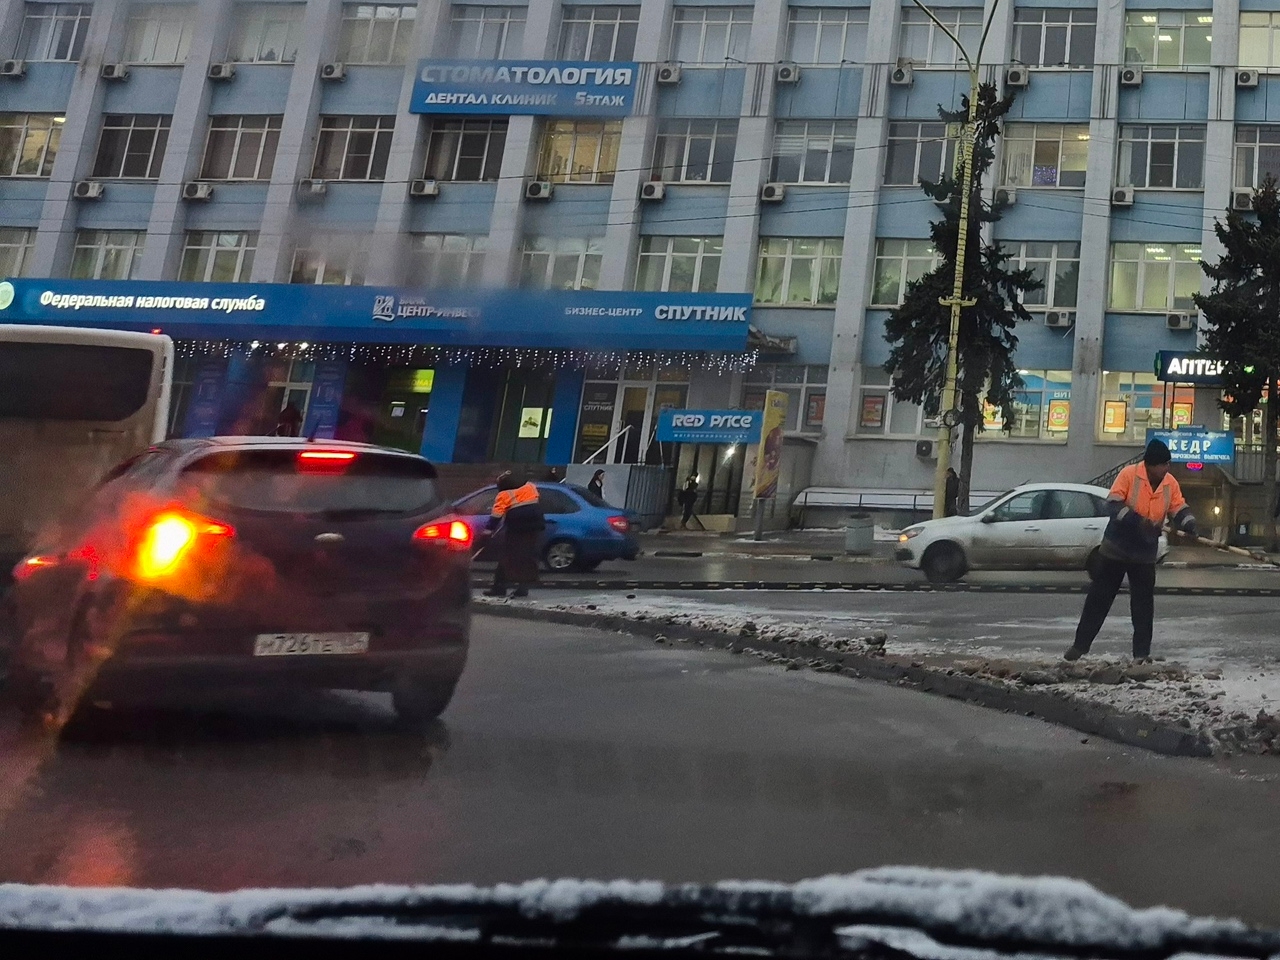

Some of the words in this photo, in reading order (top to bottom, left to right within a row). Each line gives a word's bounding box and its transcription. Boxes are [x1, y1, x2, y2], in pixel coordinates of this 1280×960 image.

[420, 65, 632, 86] СТОМАТОЛОГИЯ
[424, 92, 488, 105] ДЕНТАЛ
[40, 291, 134, 310] Федеральная
[135, 294, 209, 310] налоговая
[210, 295, 265, 313] служба
[564, 307, 643, 317] БИЗНЕС-ЦЕНТР
[654, 304, 747, 322] СПУТНИК
[1167, 357, 1232, 375] АПТЕК
[1168, 439, 1211, 453] КЕДР
